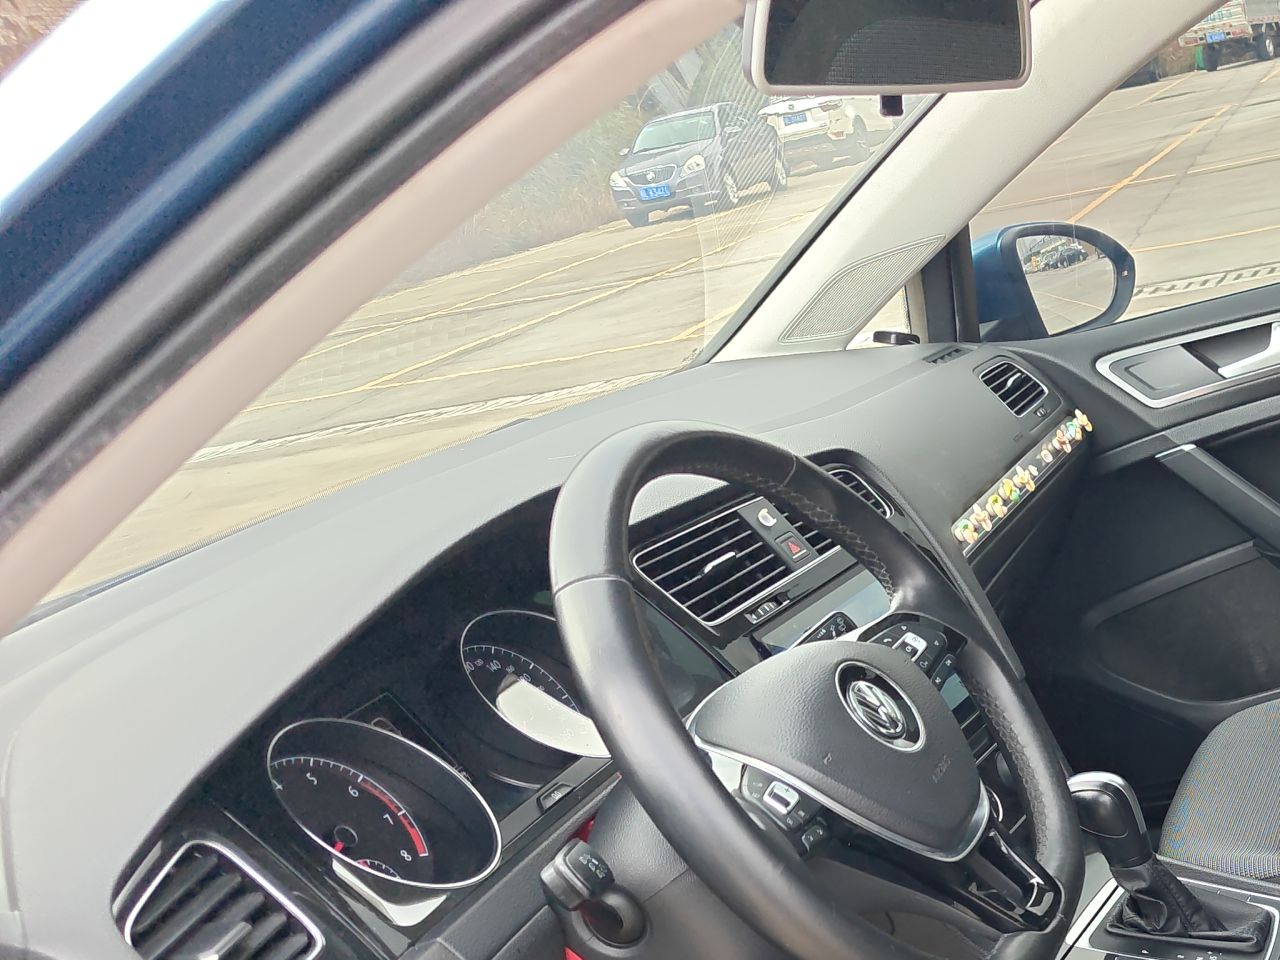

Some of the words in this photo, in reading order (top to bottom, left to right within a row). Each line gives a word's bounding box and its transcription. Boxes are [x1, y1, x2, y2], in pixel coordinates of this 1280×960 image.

[486, 660, 502, 672] 140
[306, 772, 318, 785] 5
[348, 785, 359, 797] 6
[383, 813, 394, 825] 7
[400, 849, 412, 862] 8
